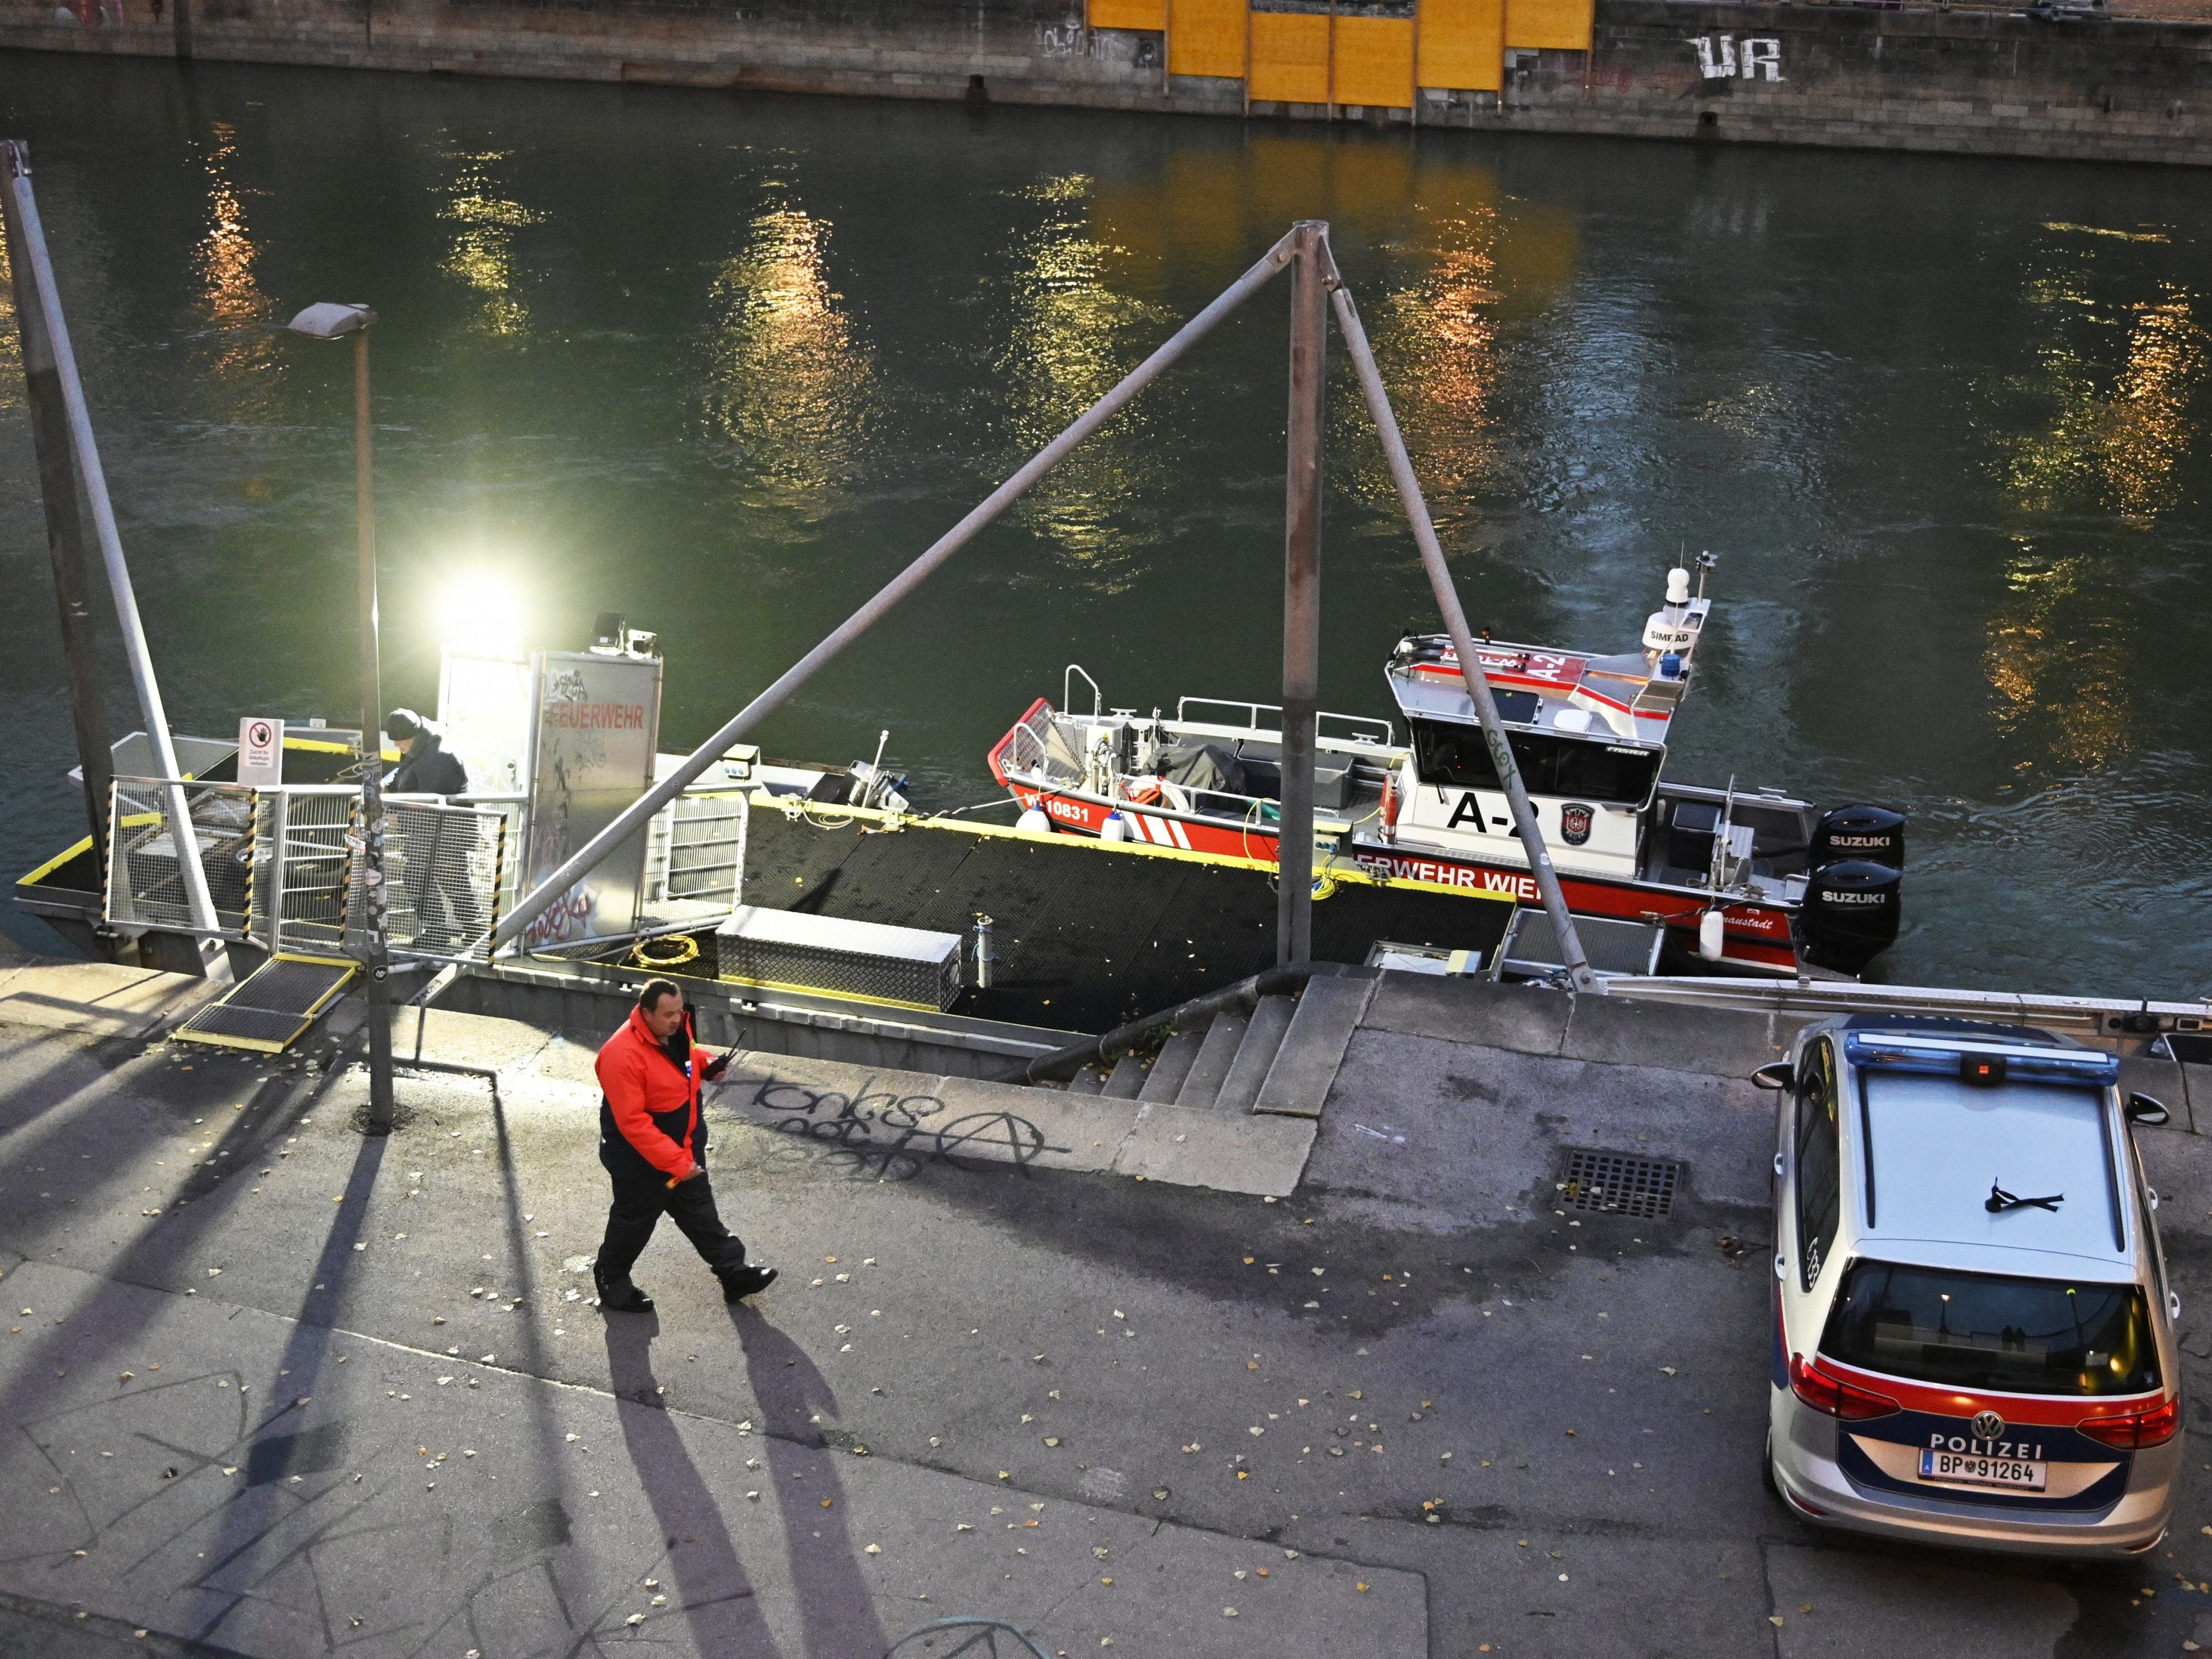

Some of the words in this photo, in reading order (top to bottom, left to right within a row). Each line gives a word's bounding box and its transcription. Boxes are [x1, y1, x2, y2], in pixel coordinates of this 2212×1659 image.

[1686, 35, 1789, 82] UR
[1527, 654, 1565, 681] A-2
[551, 703, 643, 729] FEUERWEHR
[1025, 793, 1088, 822] W10831
[1829, 836, 1890, 846] SUZUKI
[1357, 854, 1475, 888] ERWEHR
[1822, 891, 1885, 903] SUZUKI
[1723, 917, 1773, 929] naustadt
[1931, 1434, 2041, 1459] POLIZEI
[1940, 1455, 1963, 1473] BP
[1978, 1459, 2034, 1482] 91264
